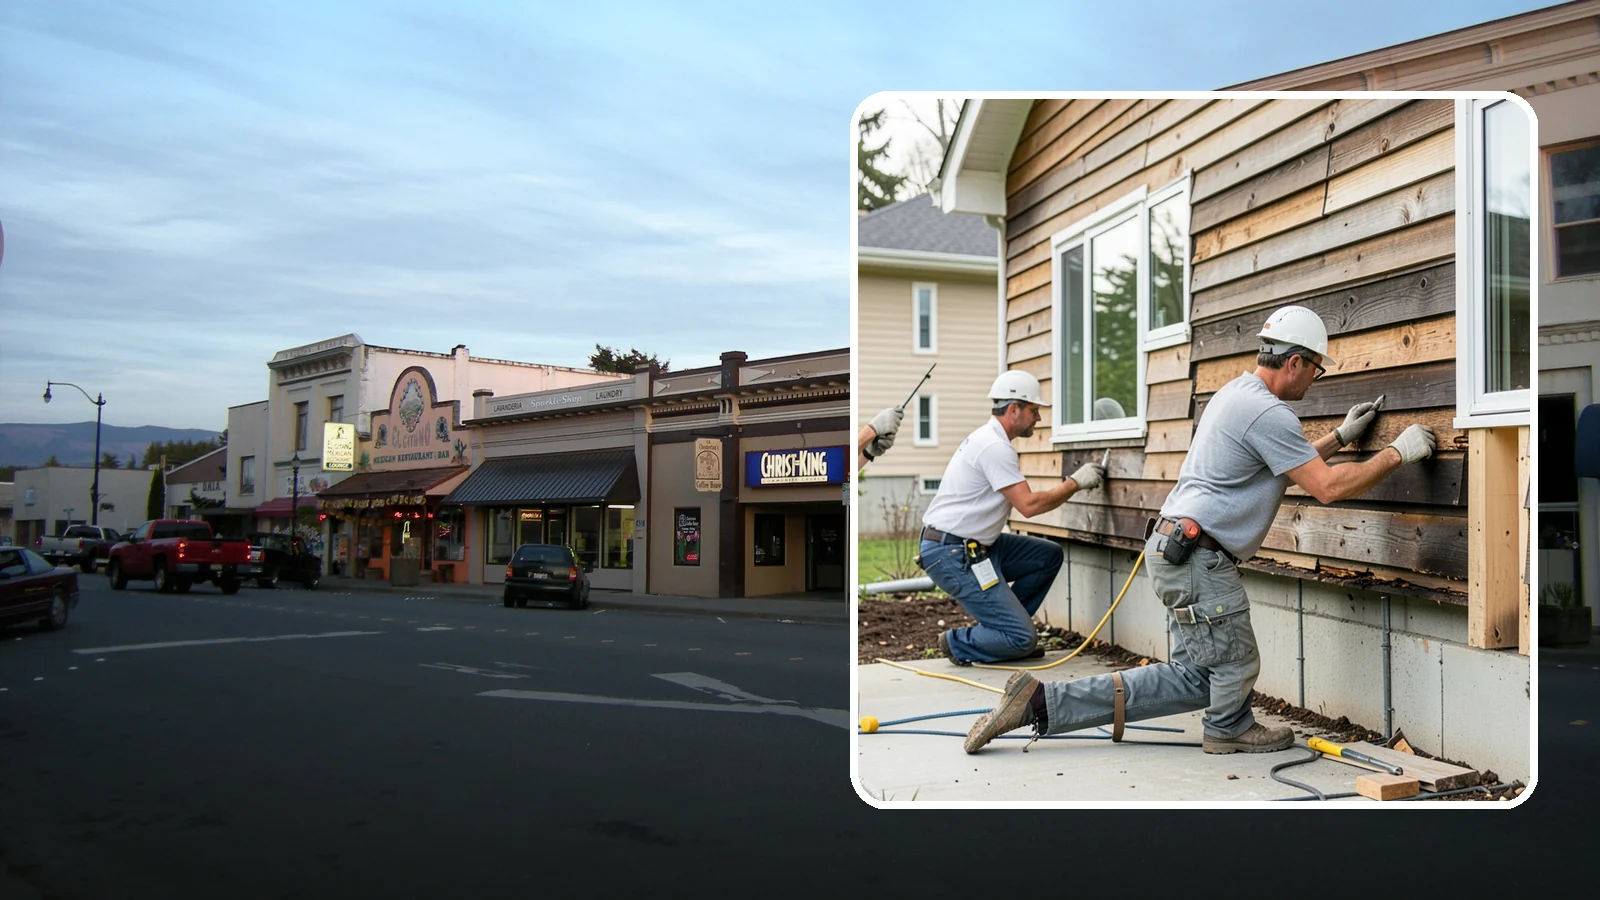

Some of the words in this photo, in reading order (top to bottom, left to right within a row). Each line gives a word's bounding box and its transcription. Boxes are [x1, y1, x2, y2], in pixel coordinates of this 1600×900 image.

[493, 402, 522, 413] LAVANDERIA
[531, 398, 561, 409] Sparkle
[562, 394, 582, 405] Shop
[595, 389, 623, 400] LAUNDRY
[373, 455, 396, 464] MEXICAN
[397, 452, 433, 462] RESTAURANT
[438, 450, 450, 460] BAR
[761, 452, 797, 478] CHRIST
[799, 450, 827, 476] KING
